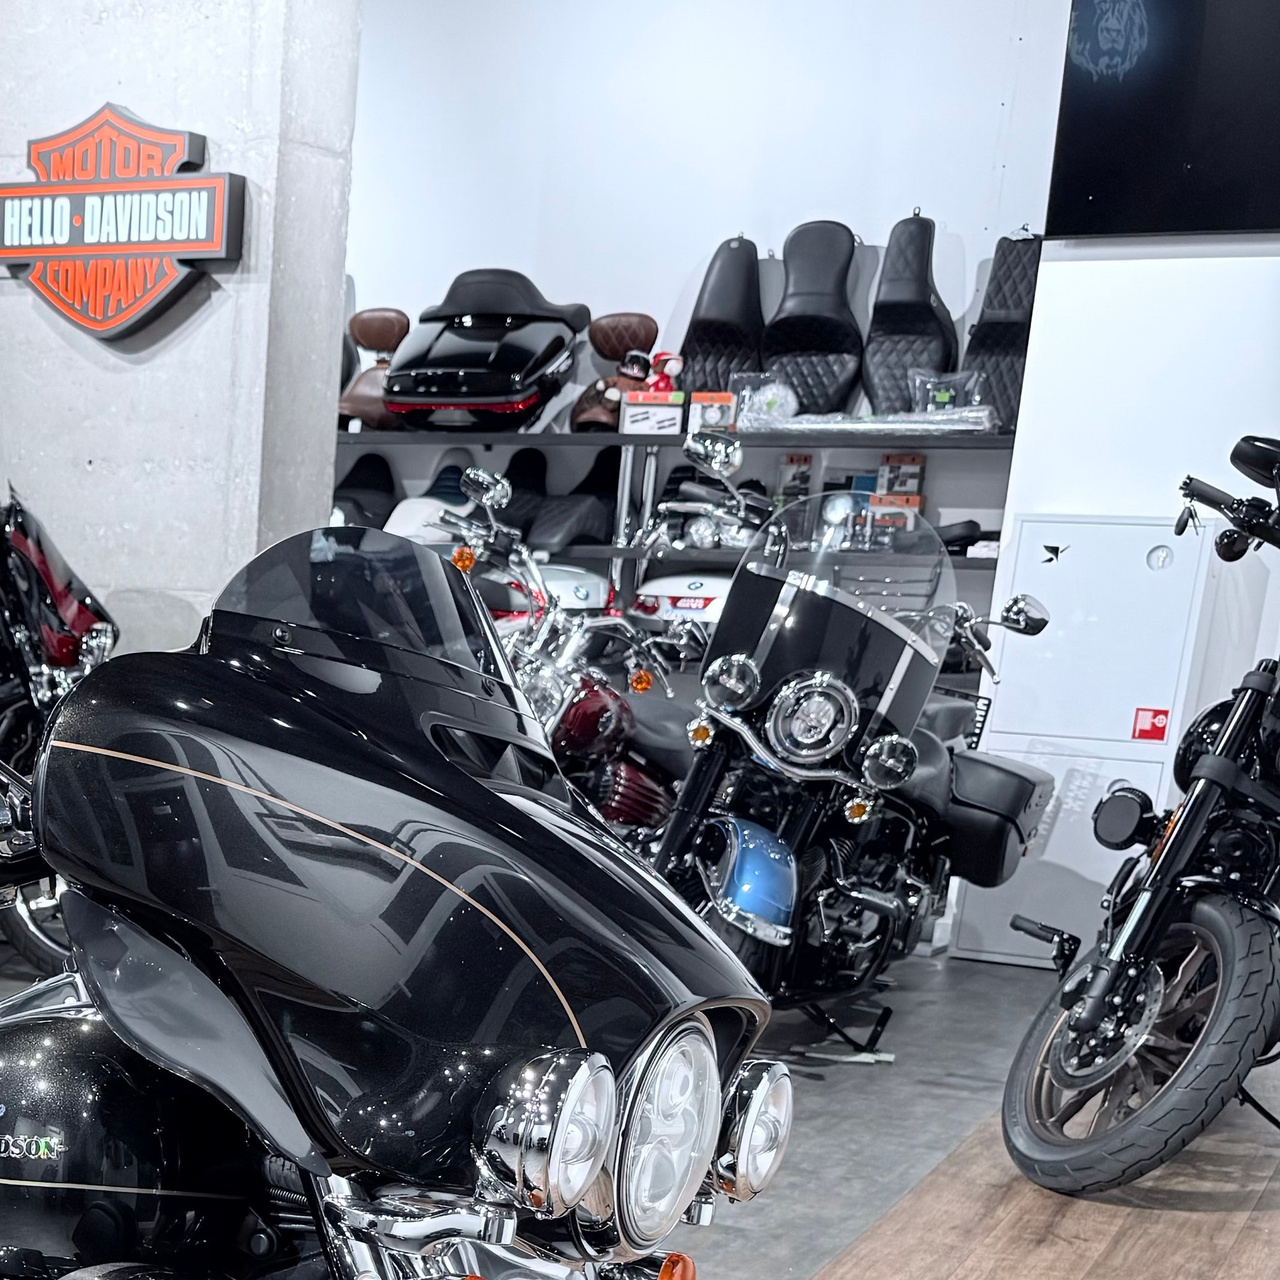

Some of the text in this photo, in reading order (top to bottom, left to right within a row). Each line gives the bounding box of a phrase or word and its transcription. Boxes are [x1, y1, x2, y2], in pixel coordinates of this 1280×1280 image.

[51, 124, 163, 181] MOTOR
[4, 190, 208, 246] HELLO DAVIDSON
[47, 258, 160, 320] COMPANY
